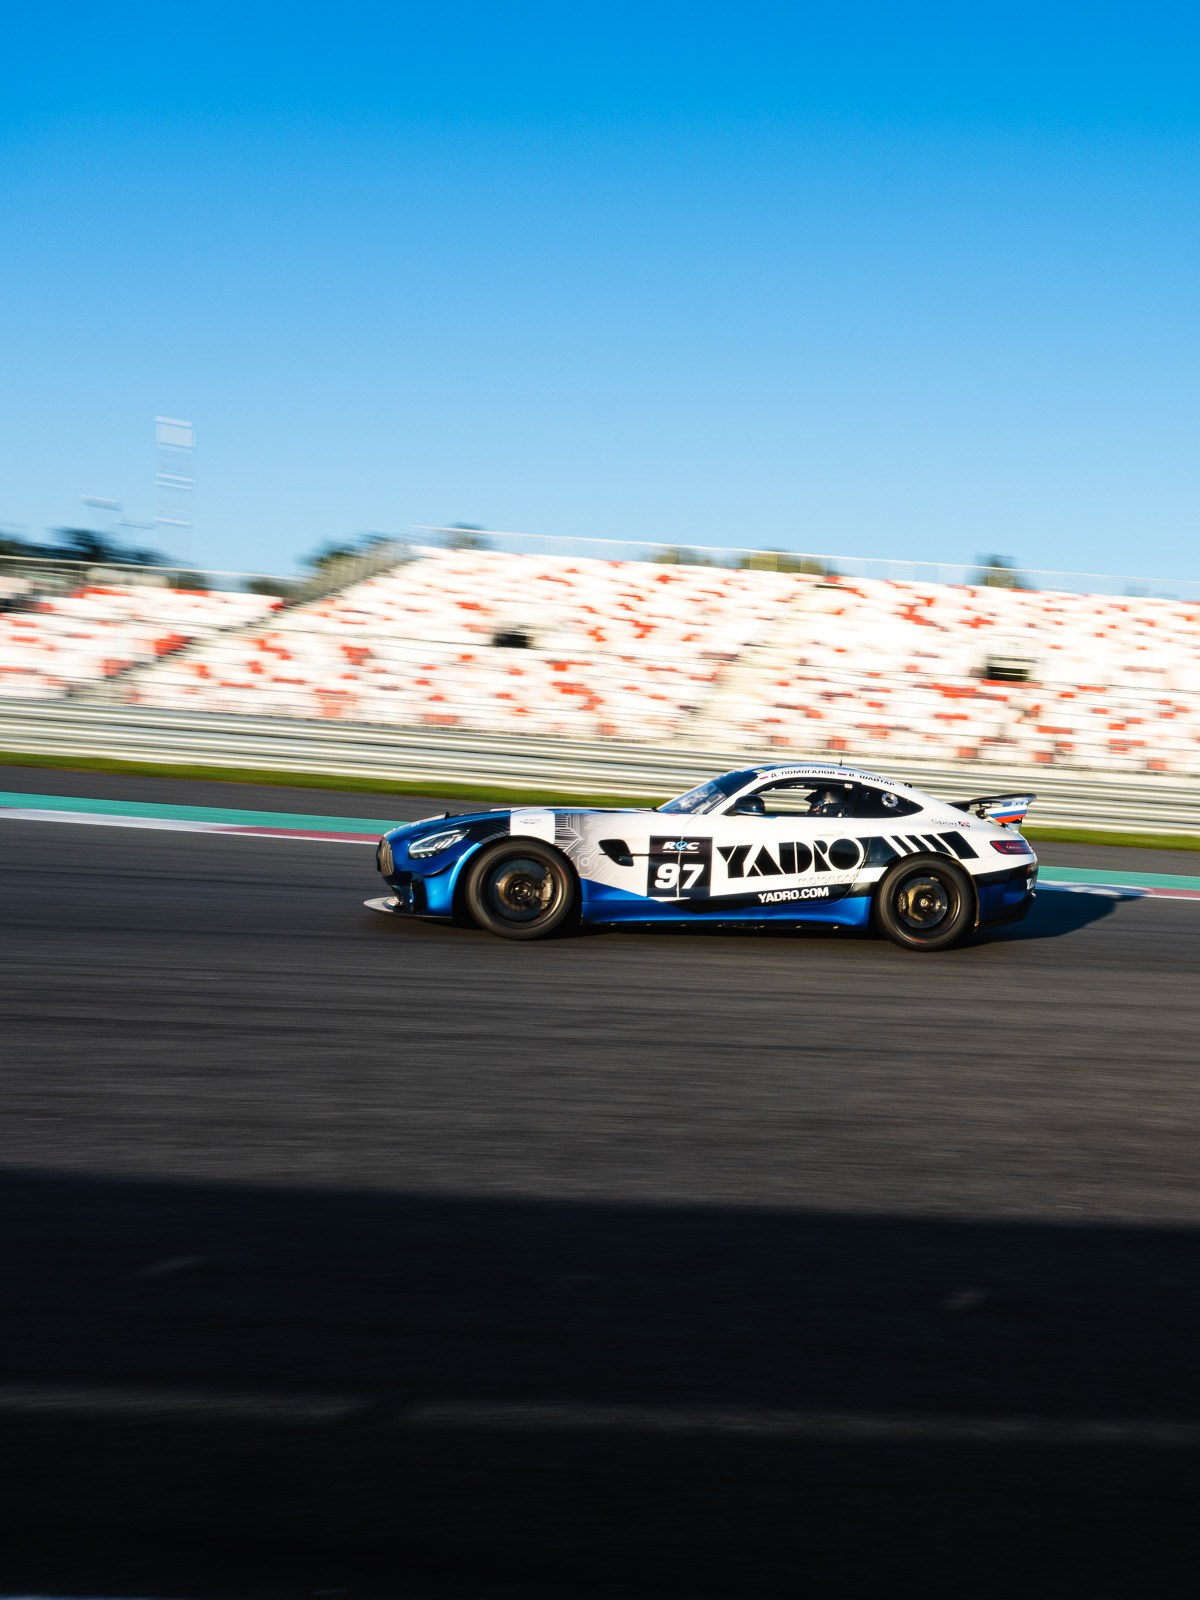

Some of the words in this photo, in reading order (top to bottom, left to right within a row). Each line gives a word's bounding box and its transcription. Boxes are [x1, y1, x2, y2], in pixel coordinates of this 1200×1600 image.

[716, 838, 861, 879] YADRO
[654, 862, 705, 890] 97
[757, 886, 830, 904] YADRO.COM
